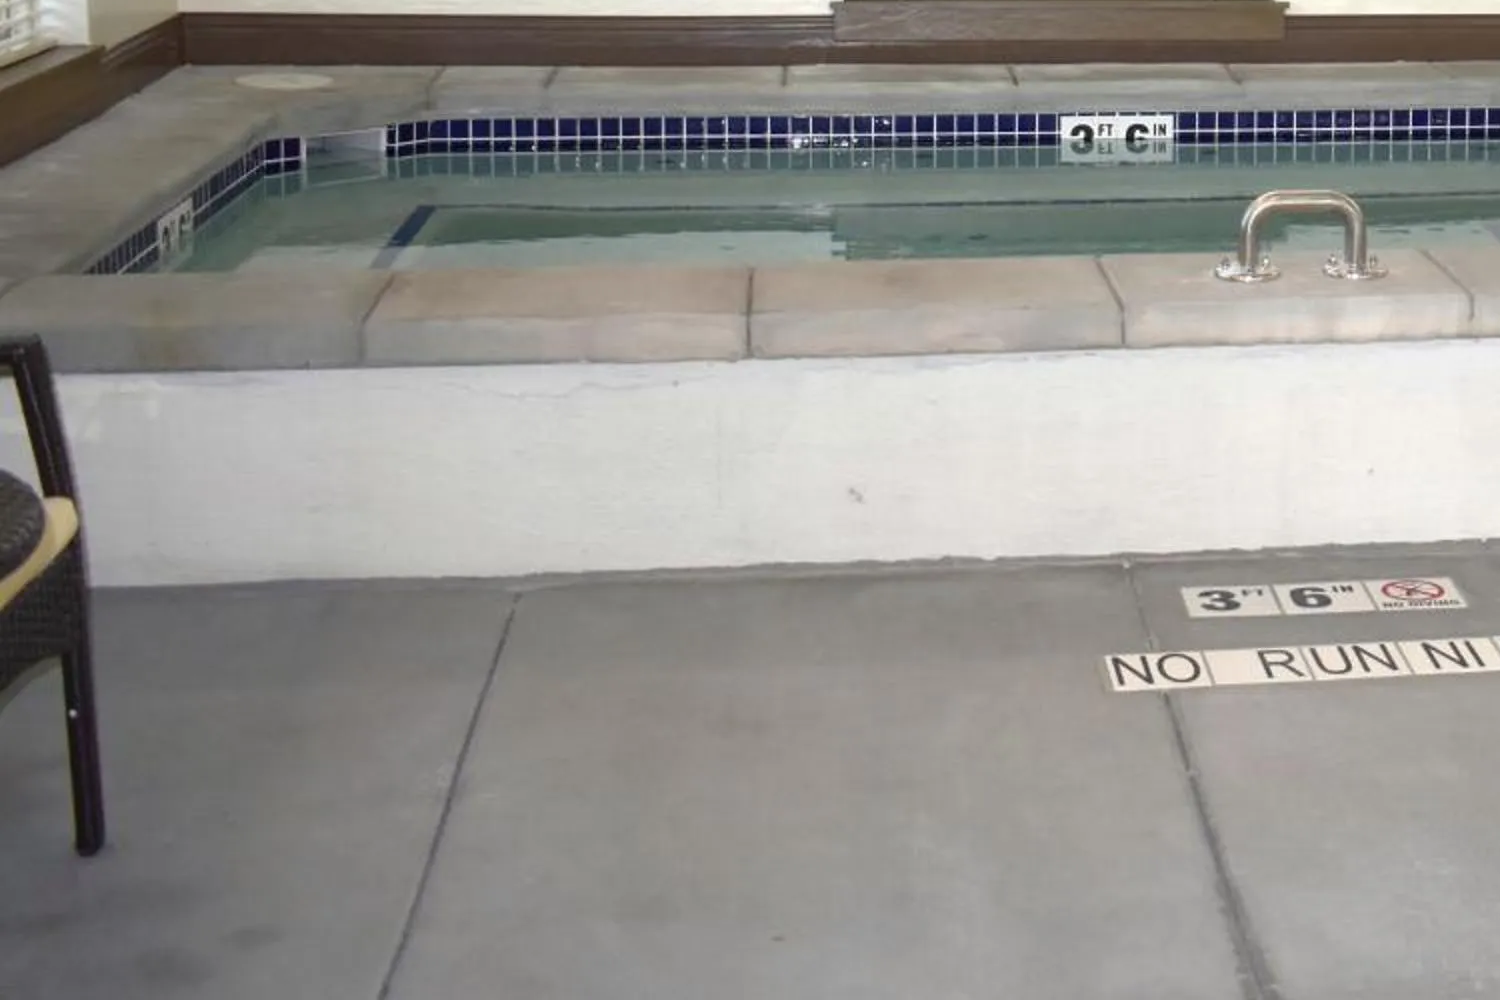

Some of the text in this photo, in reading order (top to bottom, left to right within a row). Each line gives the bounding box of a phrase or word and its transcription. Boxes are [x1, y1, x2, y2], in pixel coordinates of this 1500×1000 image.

[1098, 123, 1113, 136] FT
[1153, 123, 1166, 136] IN
[1197, 589, 1241, 612] 3
[1290, 586, 1332, 609] 6
[1111, 652, 1203, 687] NO
